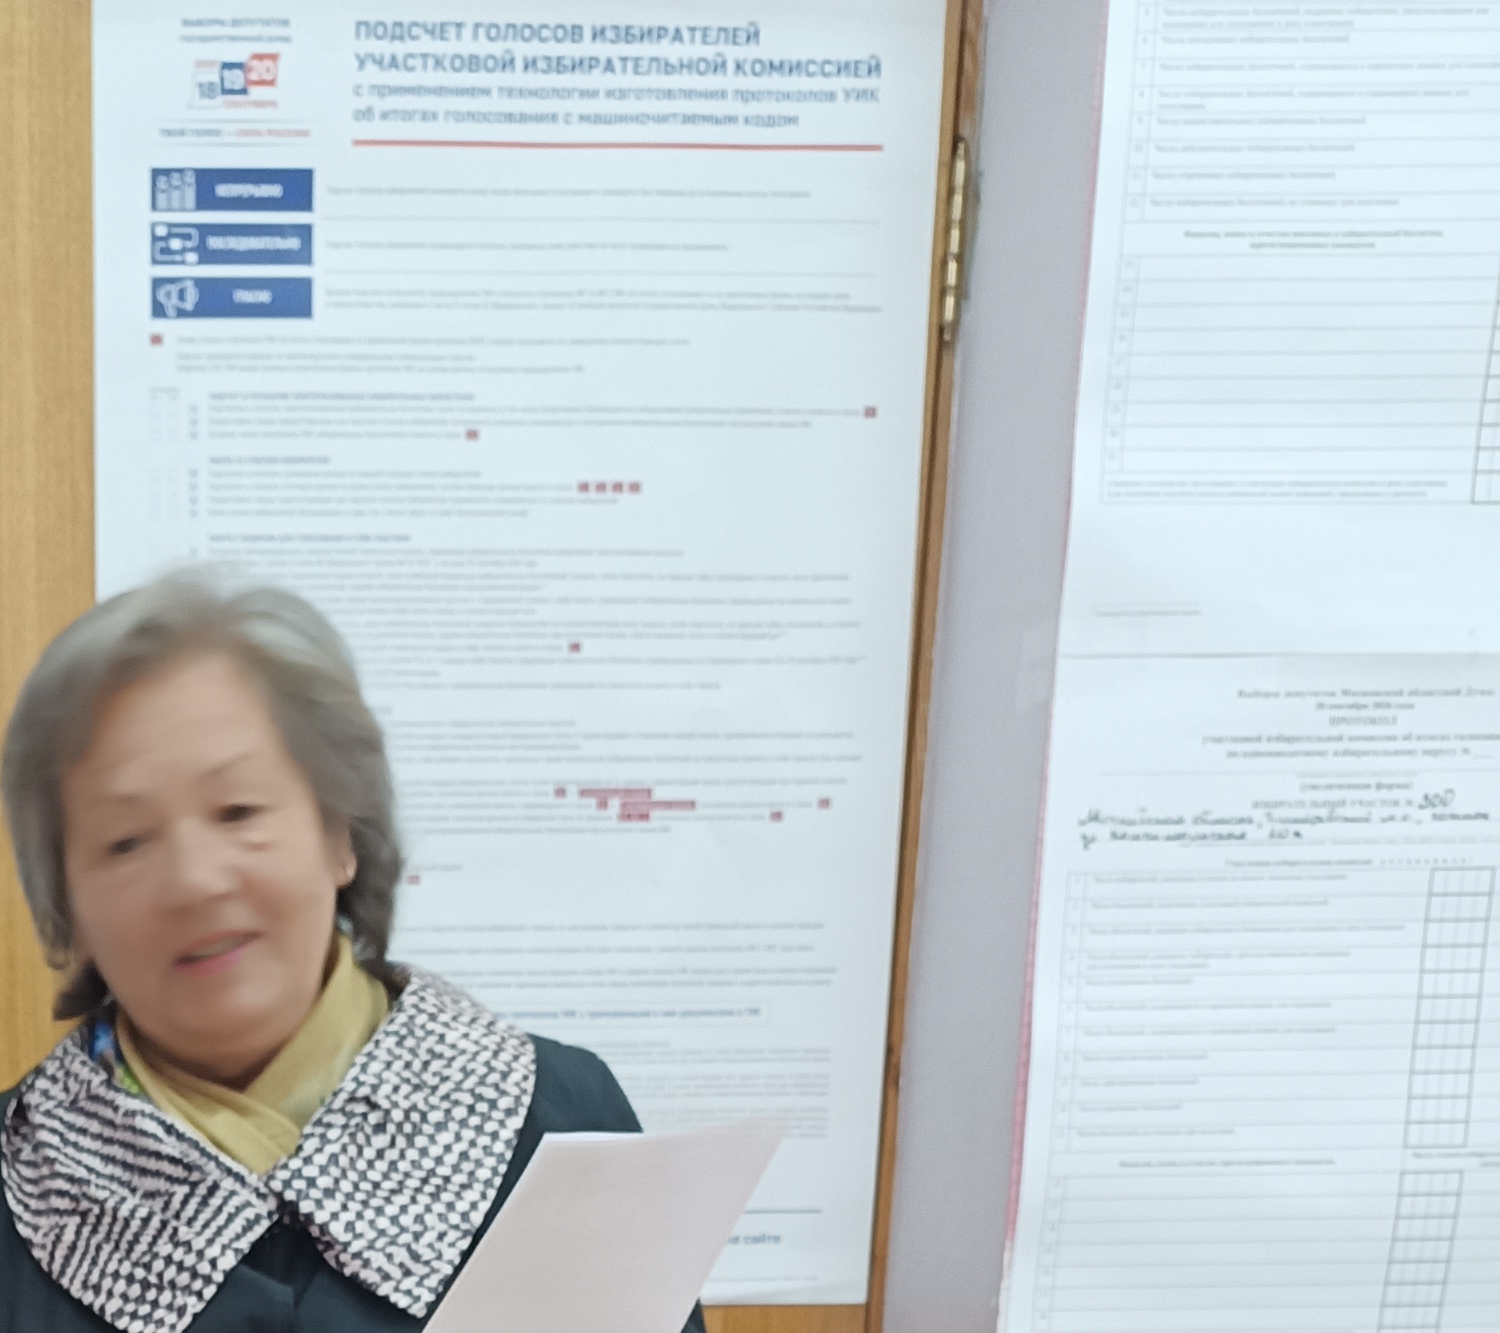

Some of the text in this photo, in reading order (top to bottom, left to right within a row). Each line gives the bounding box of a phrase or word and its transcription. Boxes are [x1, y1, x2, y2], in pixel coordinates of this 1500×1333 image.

[355, 20, 761, 46] ПОДСЧЕТ ГОЛОСОВ ИЗБИРАТЕЛЕЙ
[355, 49, 882, 78] УЧАСТКОВОЙ ИЗБИРАТЕЛЬНОЙ КОМИССИЕЙ
